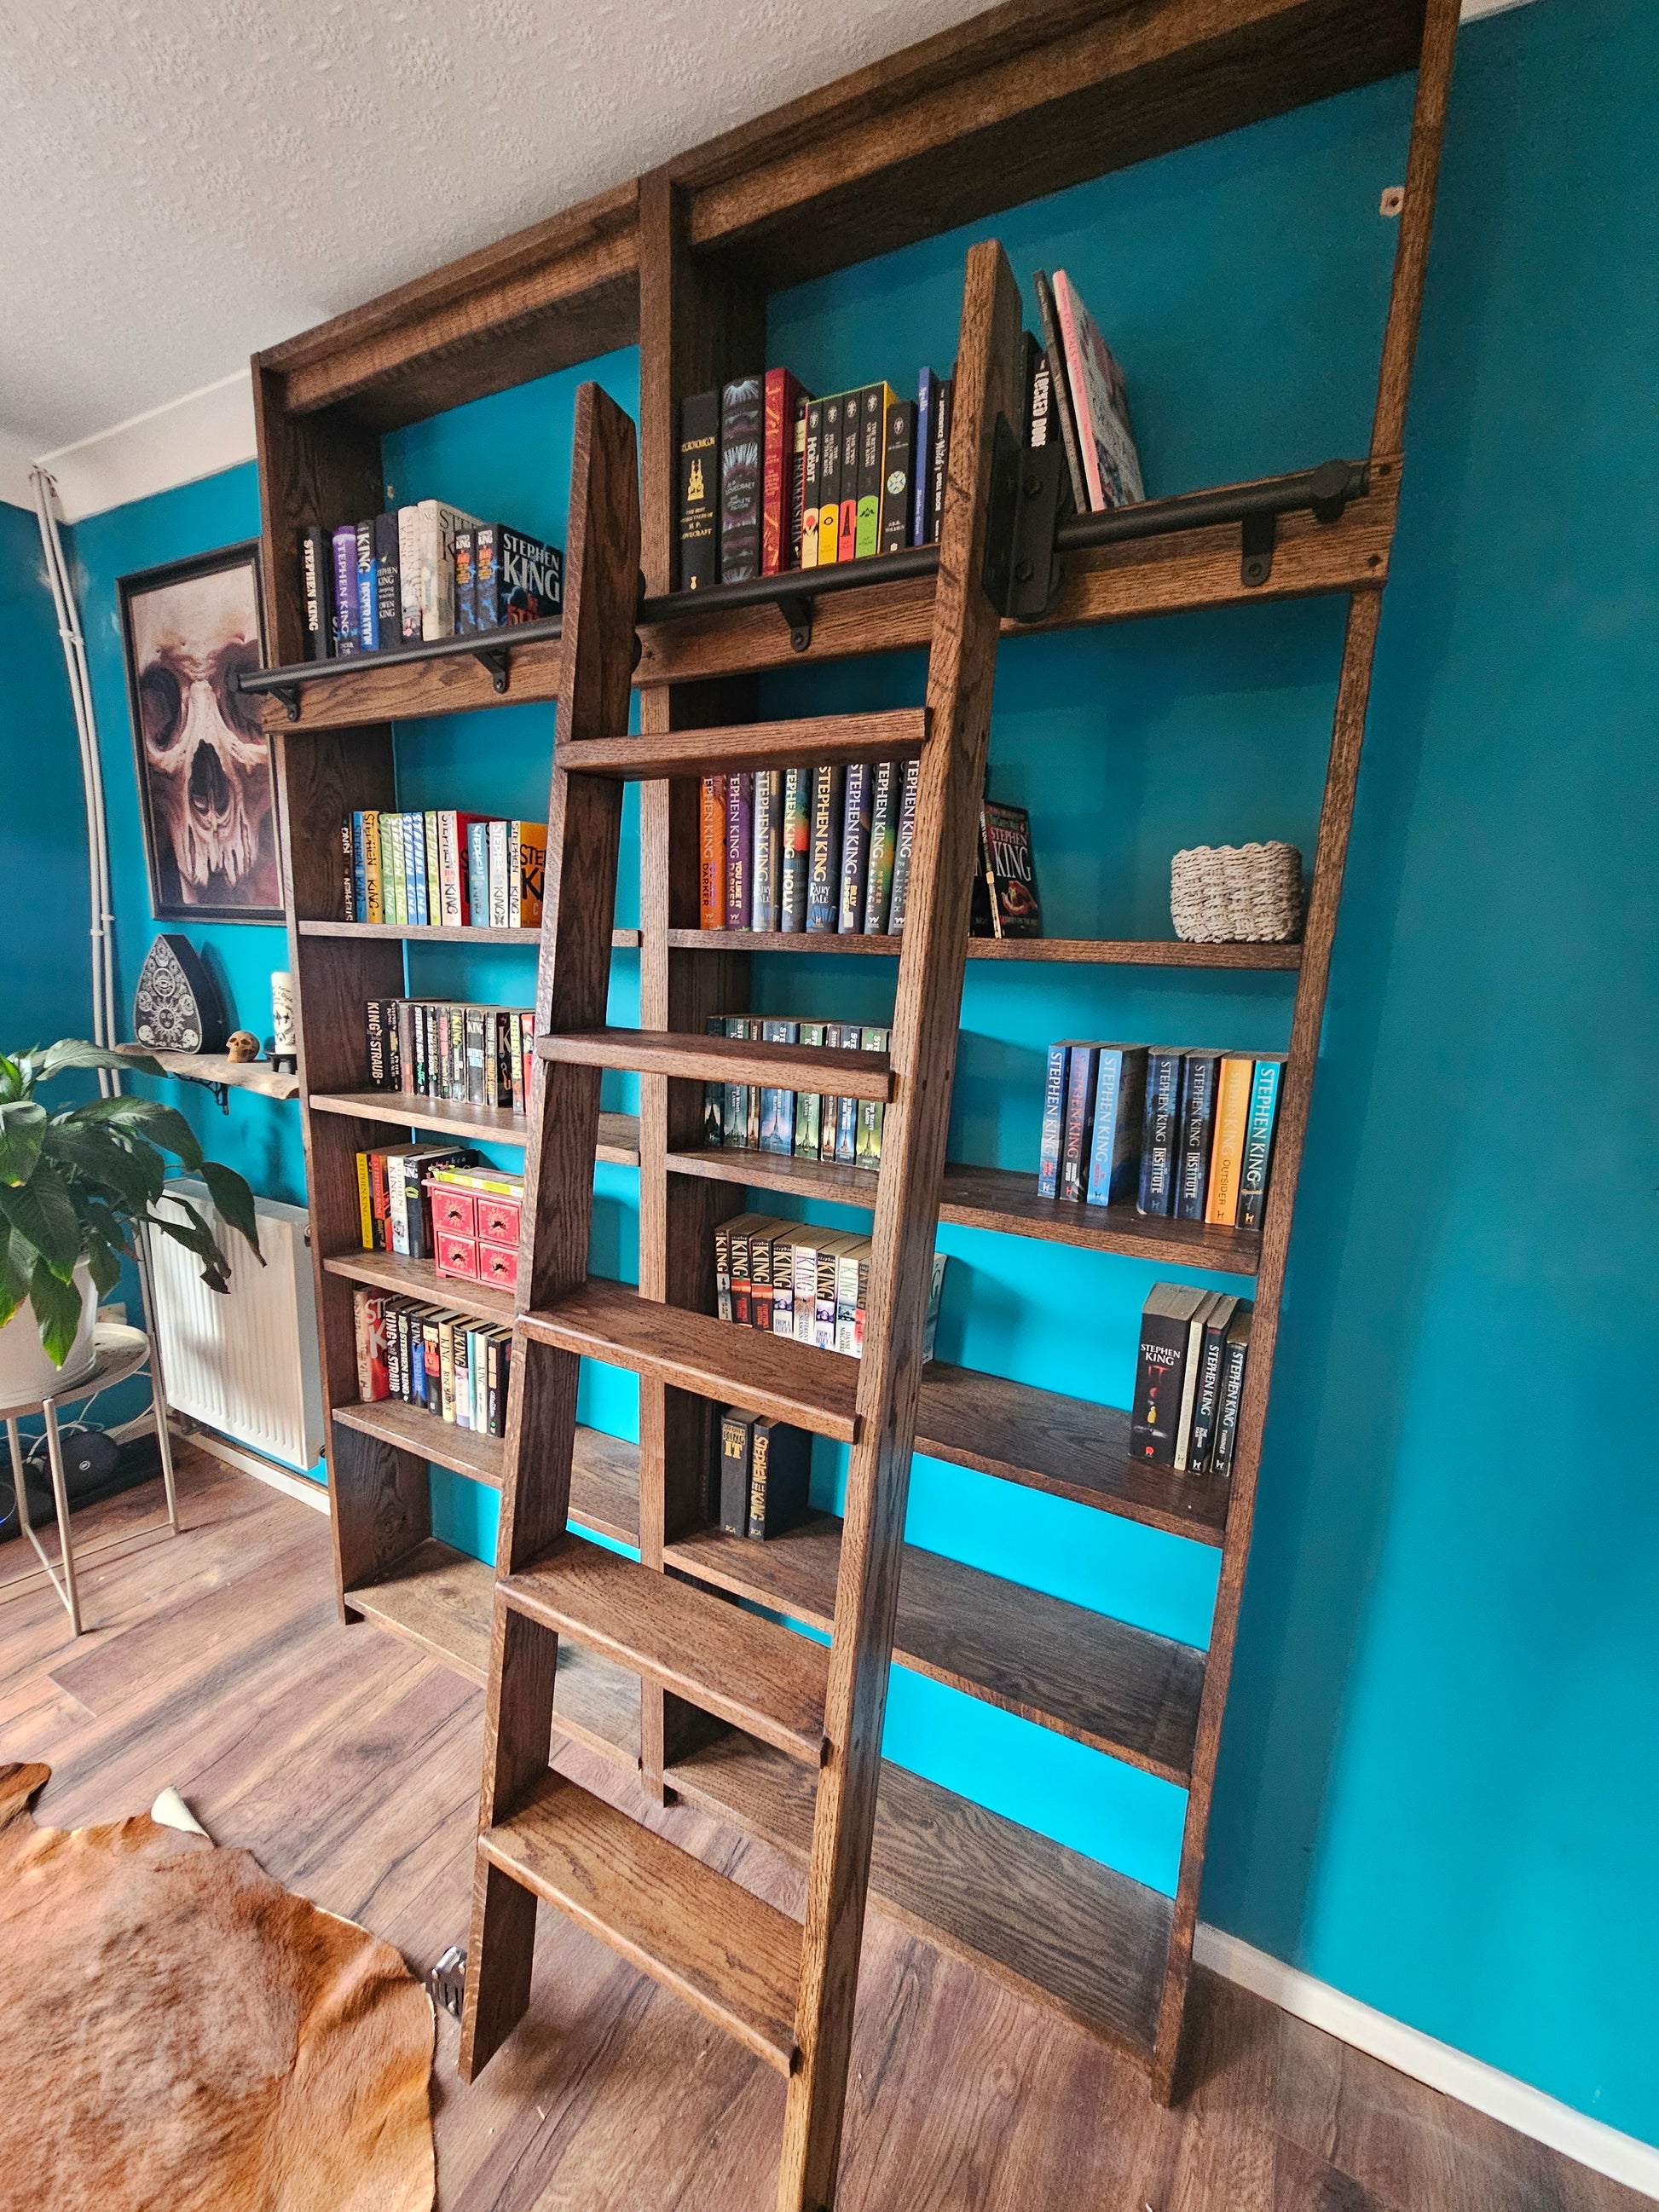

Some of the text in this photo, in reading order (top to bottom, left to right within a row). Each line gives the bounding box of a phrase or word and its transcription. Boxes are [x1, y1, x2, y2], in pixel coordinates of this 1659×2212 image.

[1032, 371, 1049, 417] LOCKED
[337, 537, 350, 598] STEPHEN
[356, 533, 372, 574] KING
[502, 532, 560, 571] STEPHEN
[303, 539, 319, 632] STEPHEN KING
[503, 549, 560, 604] KING
[338, 600, 351, 634] KING
[813, 766, 832, 882] STEPHEN KING
[845, 764, 863, 875] STEPHEN KING
[872, 762, 890, 859] TEPHEN KING
[899, 759, 920, 858] TEPHEN KING
[702, 824, 714, 858] KING
[729, 825, 740, 859] KING
[990, 827, 1028, 846] STEPHEN
[341, 827, 354, 921] STEPHEN KING
[756, 840, 769, 882] KING
[783, 823, 795, 914] KING HOLLY
[992, 840, 1032, 881] KING
[367, 879, 379, 910] KING
[445, 883, 459, 915] KING
[494, 887, 506, 915] KING
[511, 886, 519, 915] KING
[702, 863, 710, 907] DARKER
[367, 1002, 384, 1079] KING STRAUB
[1047, 1052, 1063, 1116] STEPHEN
[1066, 1054, 1087, 1158] STEPHEN KING
[1095, 1057, 1117, 1163] STEPHEN KING
[1246, 1068, 1275, 1182] STEPHEN KING
[1043, 1118, 1059, 1155] KING
[1151, 1061, 1172, 1194] STEPHEN KING INSTITUTE
[1184, 1065, 1206, 1198] STEPHEN KING INSTITUTE
[389, 1166, 398, 1198] KING
[1218, 1159, 1232, 1206] OUTSIDER
[715, 1236, 728, 1272] KING
[731, 1239, 749, 1277] KING
[752, 1245, 770, 1283] KING
[772, 1250, 792, 1288] KING
[795, 1256, 815, 1292] KING
[816, 1262, 835, 1301] KING
[385, 1310, 400, 1392] KING STRAUB
[399, 1332, 408, 1372] STEPHEN
[441, 1337, 451, 1362] KING
[454, 1334, 465, 1366] KING
[1140, 1343, 1181, 1359] STEPHEN
[1145, 1352, 1175, 1366] KING
[1147, 1365, 1170, 1384] IT
[1200, 1344, 1220, 1416] STEPHEN KING
[1227, 1351, 1244, 1399] STEPHEN
[1223, 1400, 1237, 1428] KING
[725, 1441, 743, 1459] IT
[750, 1435, 770, 1522] STEPHEN KING
